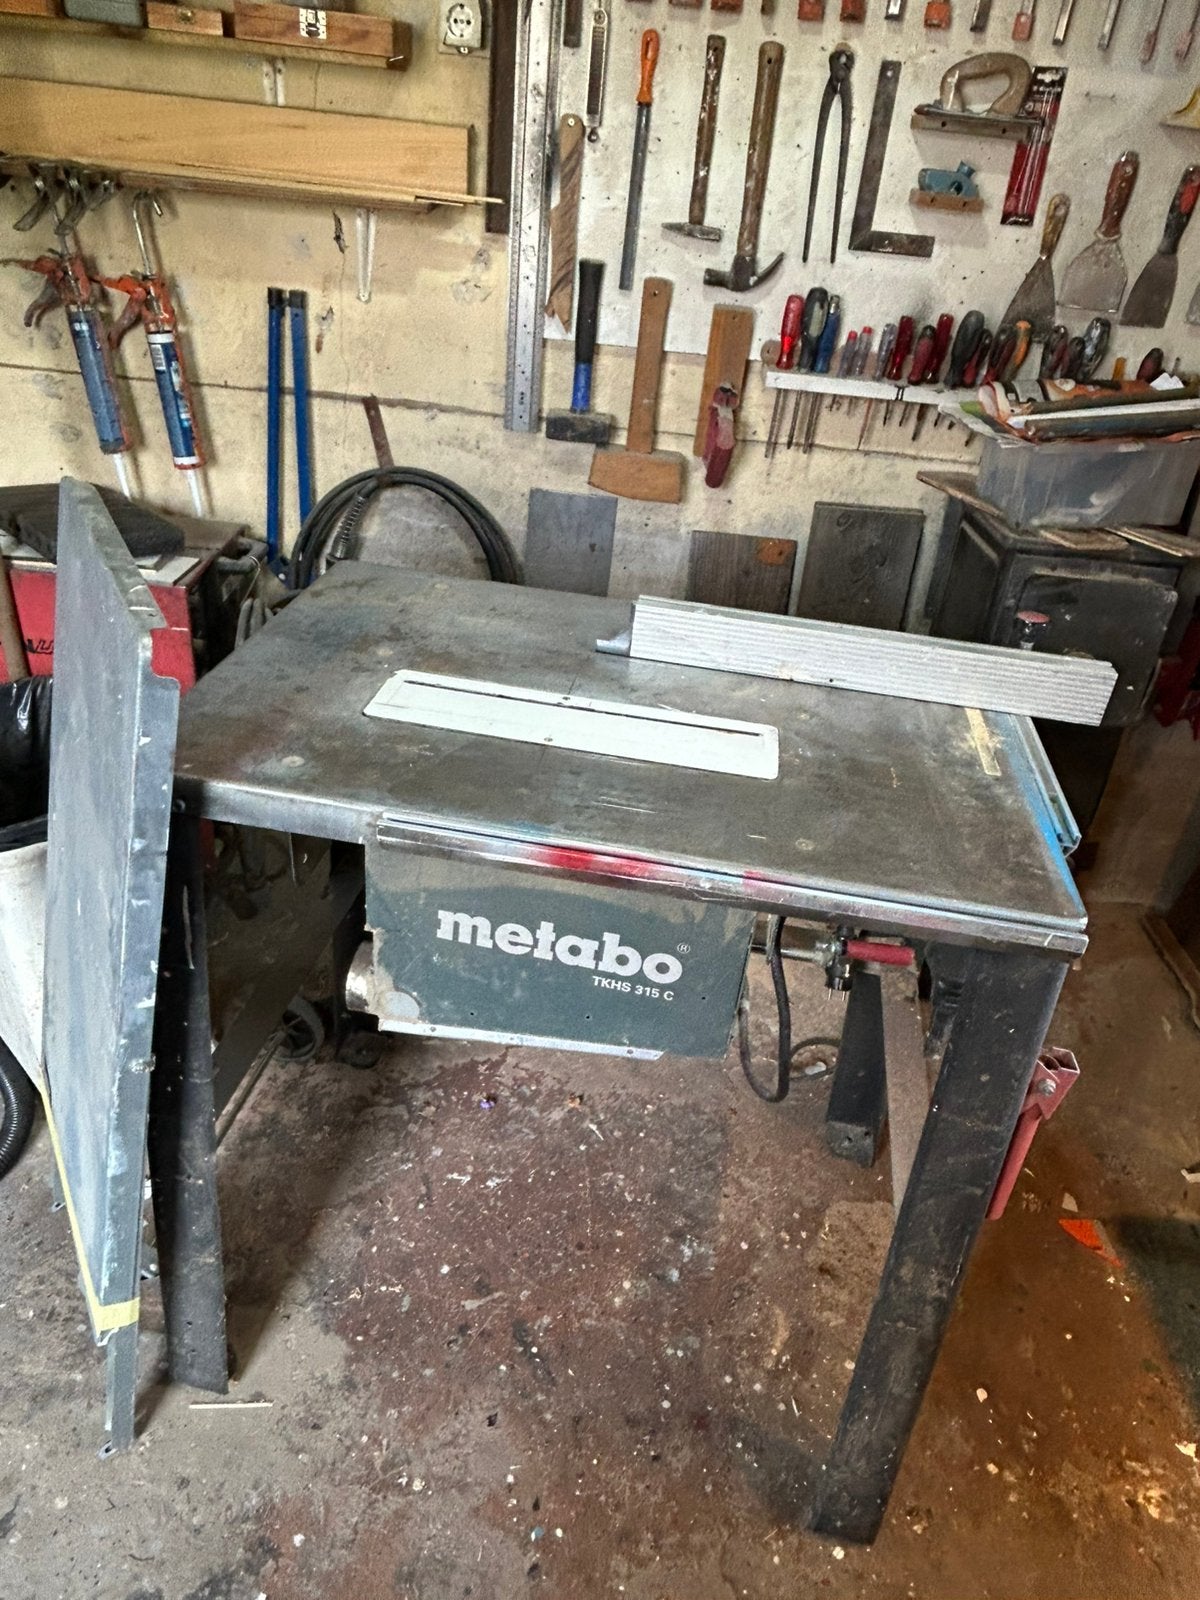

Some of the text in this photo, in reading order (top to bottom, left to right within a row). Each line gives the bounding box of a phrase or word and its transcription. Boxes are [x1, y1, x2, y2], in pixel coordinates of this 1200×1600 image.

[436, 910, 683, 984] metabo
[592, 975, 675, 1001] TKHS 315 C
